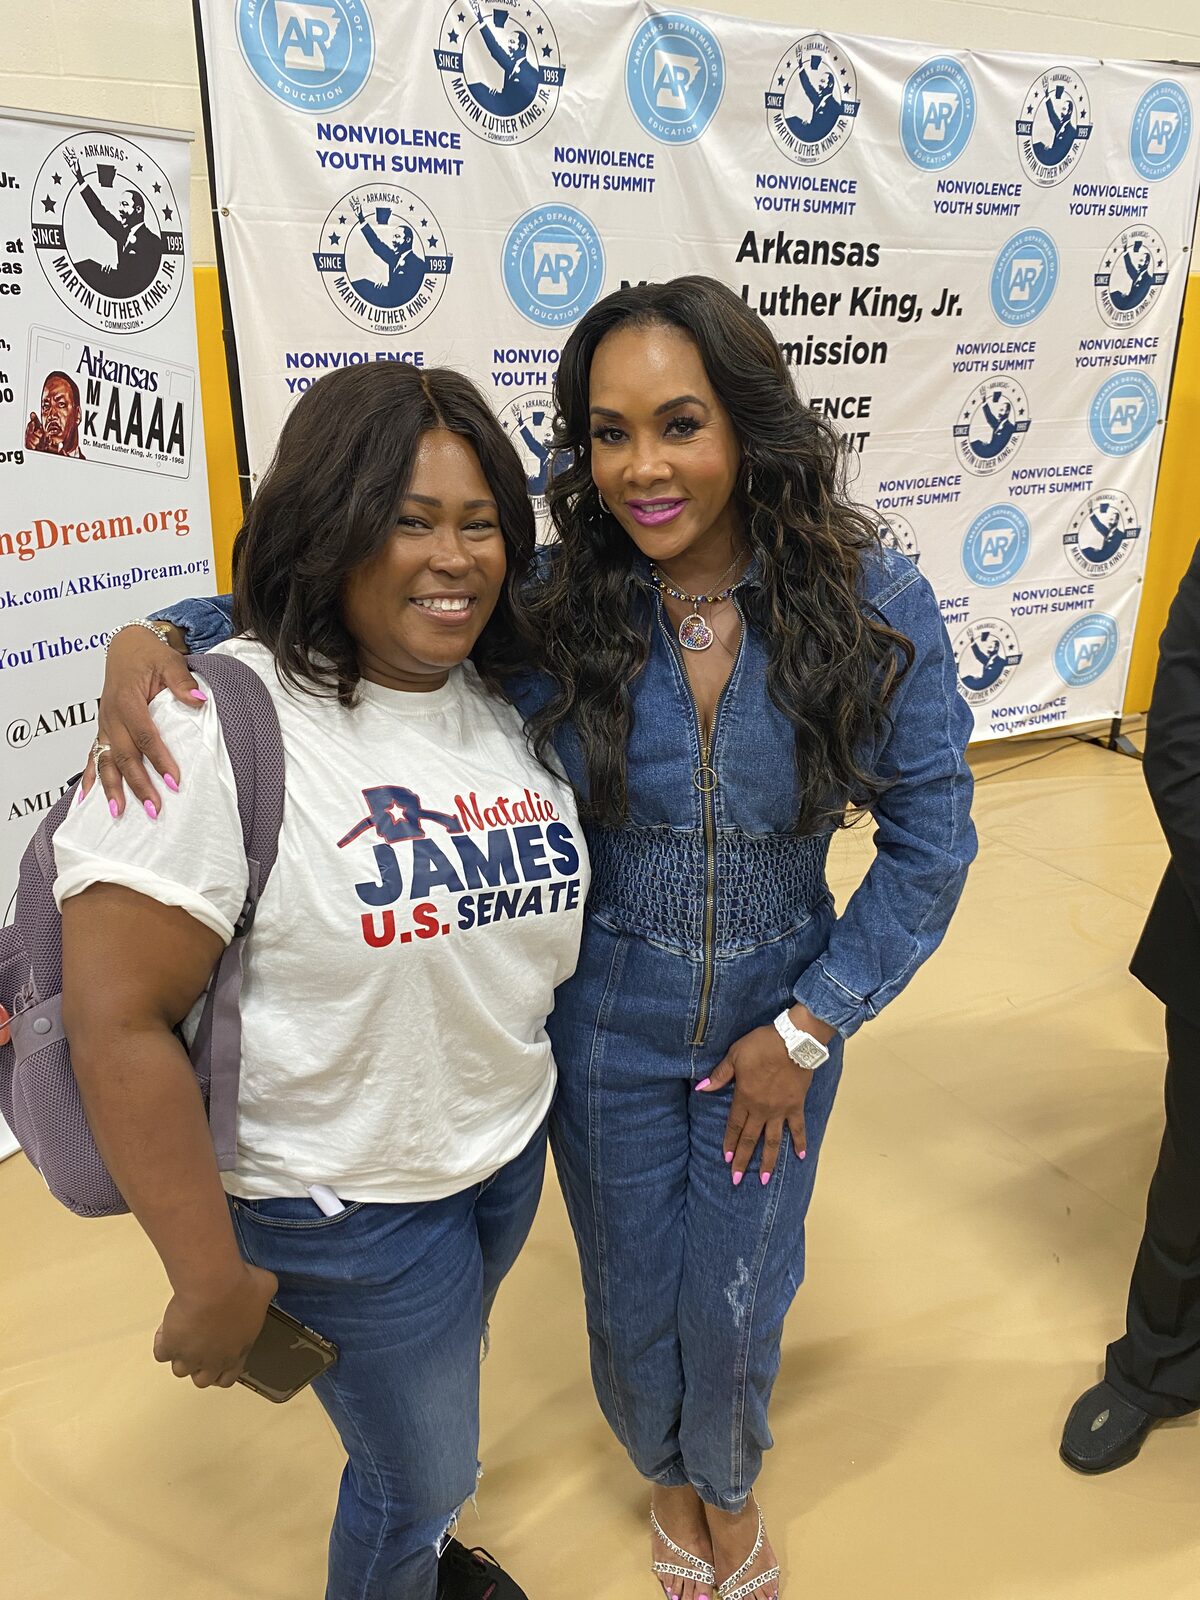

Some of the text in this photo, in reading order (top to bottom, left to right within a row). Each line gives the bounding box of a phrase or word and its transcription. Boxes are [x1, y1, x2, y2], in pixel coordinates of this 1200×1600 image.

[353, 15, 363, 32] OF
[633, 23, 663, 65] ARKANSAS
[668, 22, 715, 60] DEPARTMENT
[438, 53, 459, 69] SINCE
[543, 69, 559, 82] 1993
[277, 80, 343, 102] EDUCATION
[451, 77, 551, 134] MARTIN LUTHER KING, JR.
[767, 96, 782, 107] SINCE
[648, 116, 698, 135] EDUCATION
[316, 123, 462, 150] NONVIOLENCE
[488, 133, 514, 142] COMMISSION
[773, 113, 795, 148] MARTIN
[794, 143, 820, 157] LUTHER
[83, 144, 125, 161] ARKANSAS
[554, 147, 655, 169] NONVIOLENCE
[1023, 139, 1038, 175] MARTIN
[1036, 166, 1058, 179] LUTHER
[316, 150, 464, 176] YOUTH SUMMIT
[551, 172, 656, 193] YOUTH SUMMIT
[756, 174, 857, 194] NONVIOLENCE
[936, 180, 1022, 197] NONVIOLENCE
[366, 193, 400, 204] ARKANSAS
[1072, 184, 1148, 199] NONVIOLENCE
[753, 196, 856, 215] YOUTH SUMMIT
[933, 200, 1021, 216] YOUTH SUMMIT
[1069, 203, 1148, 217] YOUTH SUMMIT
[33, 228, 60, 245] SINCE
[166, 236, 183, 251] 1993
[512, 216, 543, 257] ARKANSAS
[546, 213, 593, 244] DEPARTMENT
[6, 238, 24, 253] at
[736, 231, 880, 267] Arkansas
[319, 256, 342, 269] SINCE
[430, 259, 446, 271] 1993
[53, 255, 176, 319] MARTIN LUTHER KING, JR.
[334, 276, 437, 324] MARTIN LUTHER KING, JR.
[742, 285, 963, 323] Luther King, Jr.
[529, 305, 579, 320] EDUCATION
[104, 320, 140, 329] COMMISSION
[956, 341, 1036, 355] NONVIOLENCE
[1079, 337, 1159, 350] NONVIOLENCE
[494, 349, 561, 363] NONVIO
[1075, 354, 1157, 367] YOUTH SUMMIT
[76, 345, 158, 392] Arkansas
[952, 359, 1034, 373] YOUTH SUMMIT
[492, 372, 547, 386] YOUTH
[525, 399, 552, 409] ARKANSAS
[103, 386, 185, 456] AAAA
[93, 441, 111, 450] Martin
[112, 444, 129, 454] Luther
[130, 448, 144, 458] King,
[155, 453, 168, 461] 1929
[1012, 465, 1093, 480] NONVIOLENCE
[879, 475, 962, 492] NONVIOLENCE
[1009, 481, 1093, 496] YOUTH SUMMIT
[876, 491, 961, 509] YOUTH SUMMIT
[1013, 585, 1094, 601] NONVIOLENCE
[1010, 599, 1094, 617] YOUTH SUMMIT
[1028, 711, 1067, 725] SUMMIT
[454, 788, 560, 832] Natalie
[354, 822, 580, 907] JAMES
[361, 879, 581, 948] U.S. SENATE
